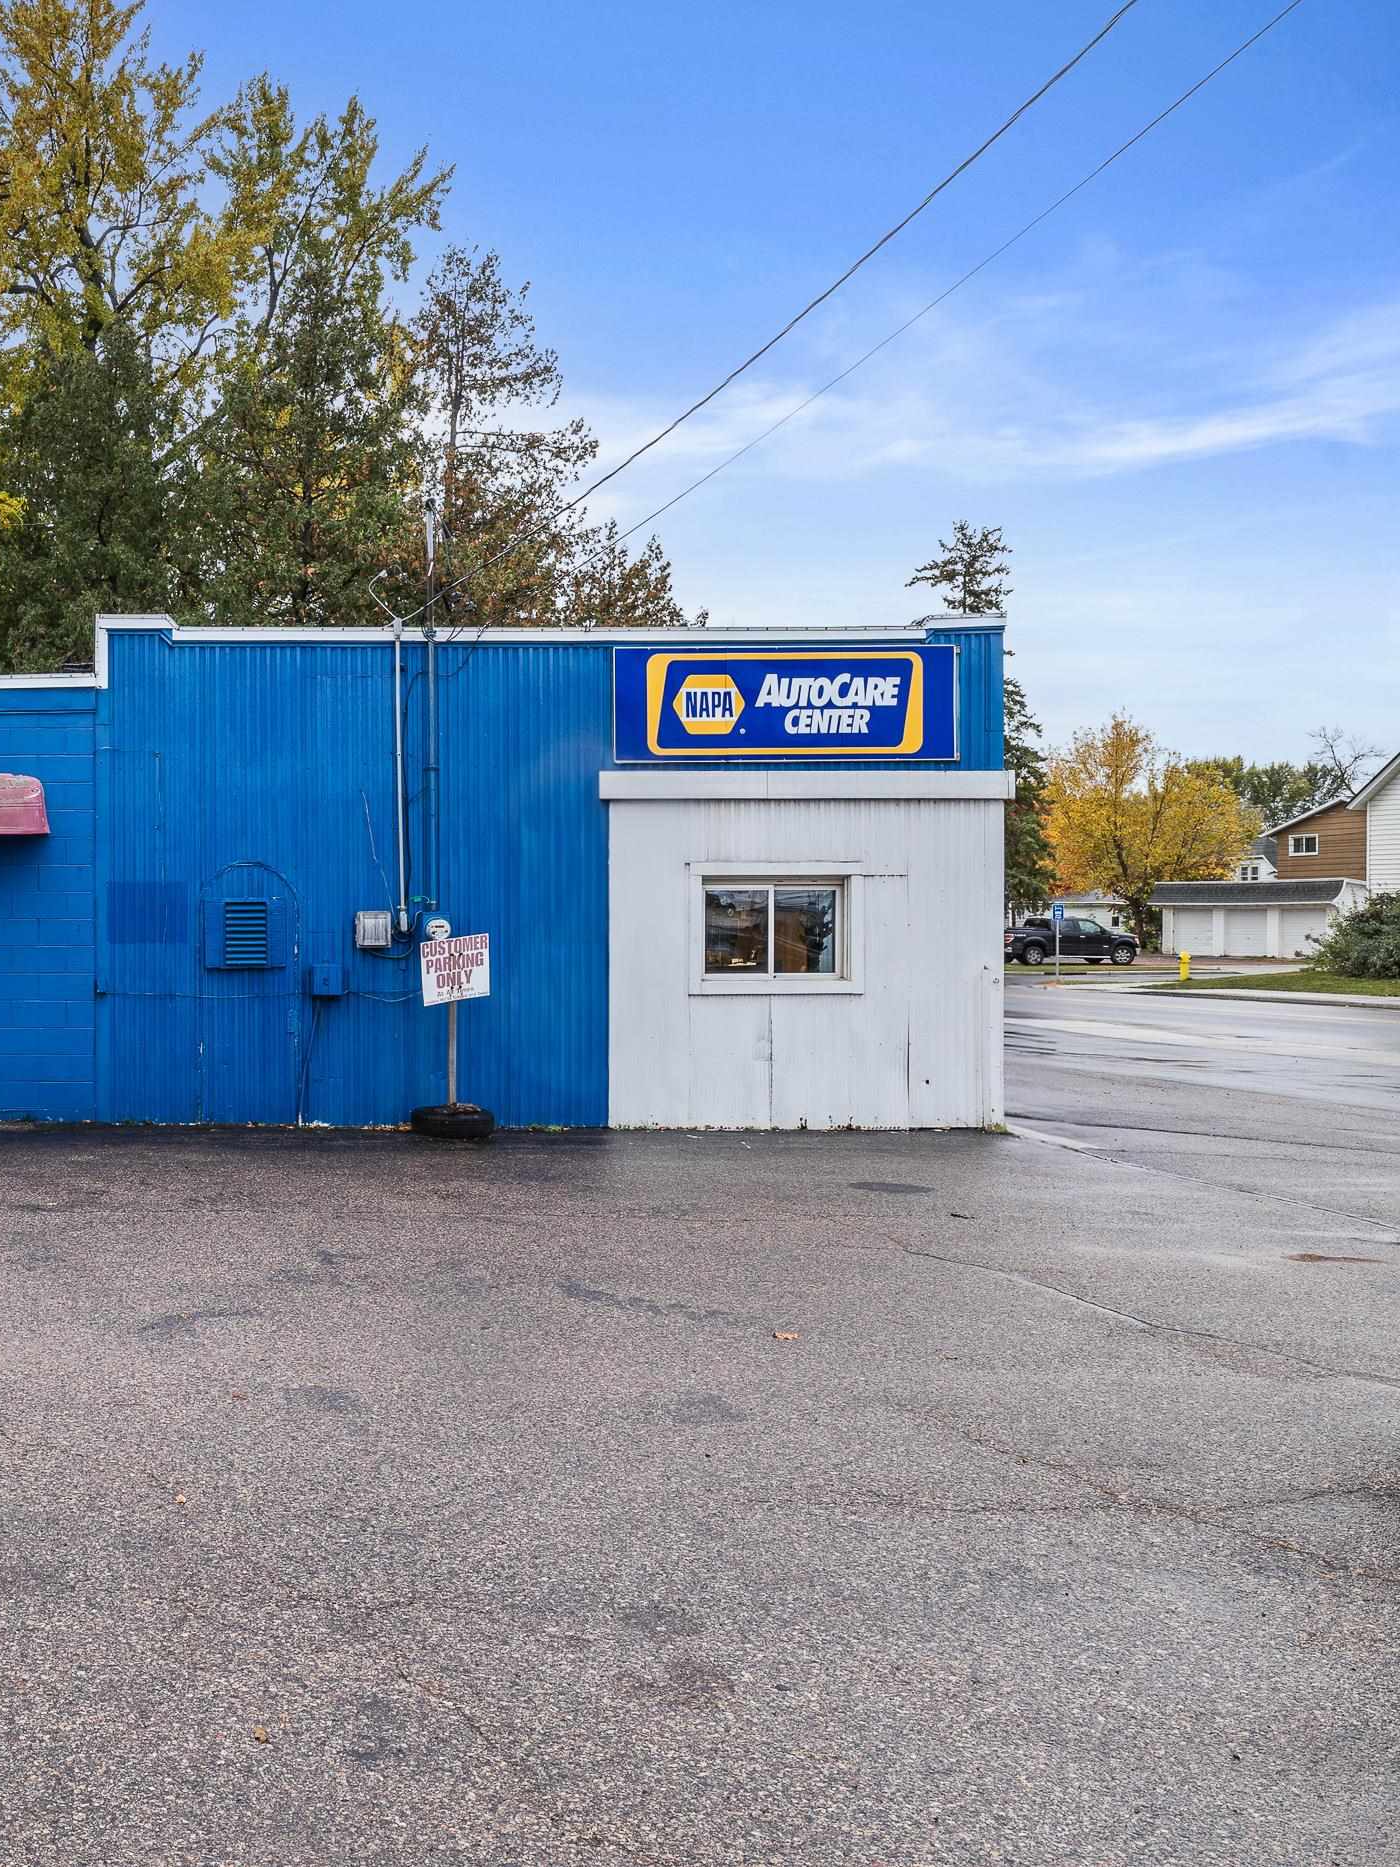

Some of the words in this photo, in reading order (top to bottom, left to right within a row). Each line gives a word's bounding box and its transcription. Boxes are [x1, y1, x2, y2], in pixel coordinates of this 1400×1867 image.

[685, 691, 733, 718] NAPA
[784, 708, 871, 735] CENTER
[422, 935, 488, 958] CUSTOMER
[426, 952, 484, 974] PARKING
[436, 969, 473, 989] ONLY
